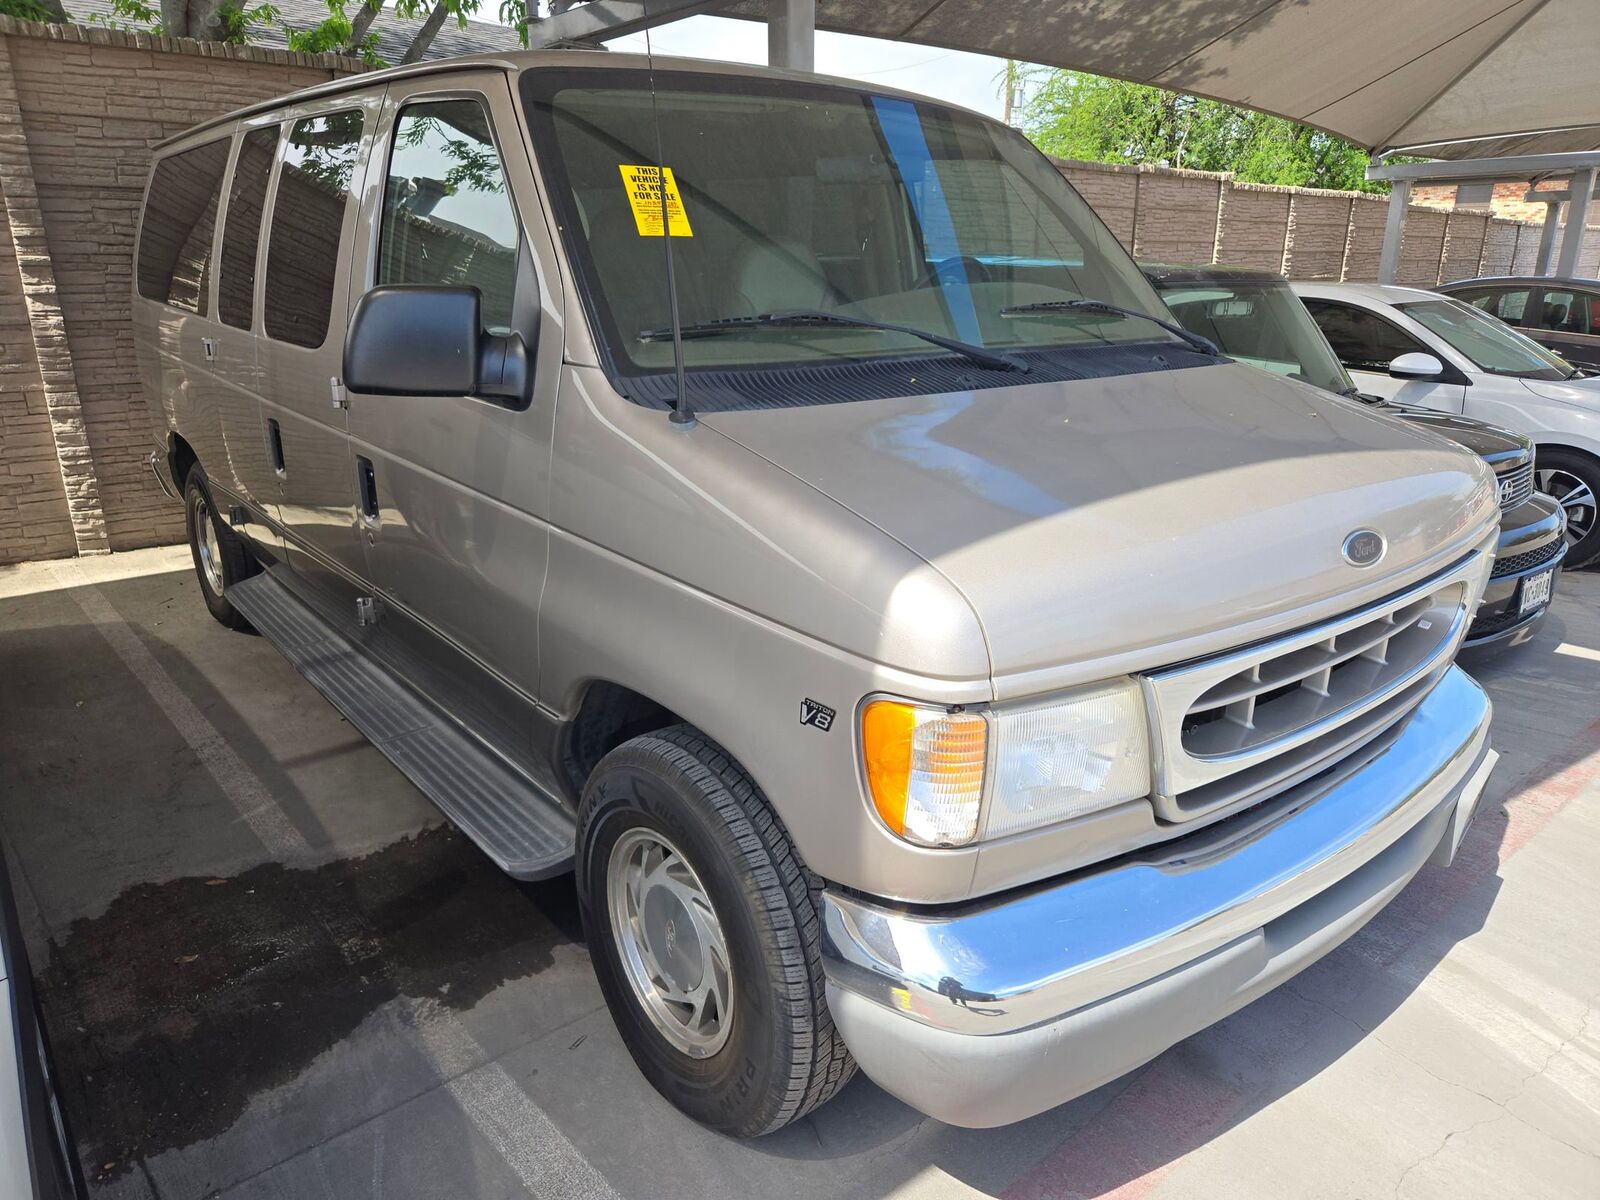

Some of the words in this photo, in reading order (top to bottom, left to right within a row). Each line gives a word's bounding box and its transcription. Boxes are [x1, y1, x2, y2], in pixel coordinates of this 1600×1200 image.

[635, 167, 658, 175] THIS
[630, 175, 669, 184] VEHICE
[634, 192, 652, 200] FOR
[654, 192, 676, 201] SLE
[805, 699, 834, 716] TRITON
[801, 703, 831, 729] V8
